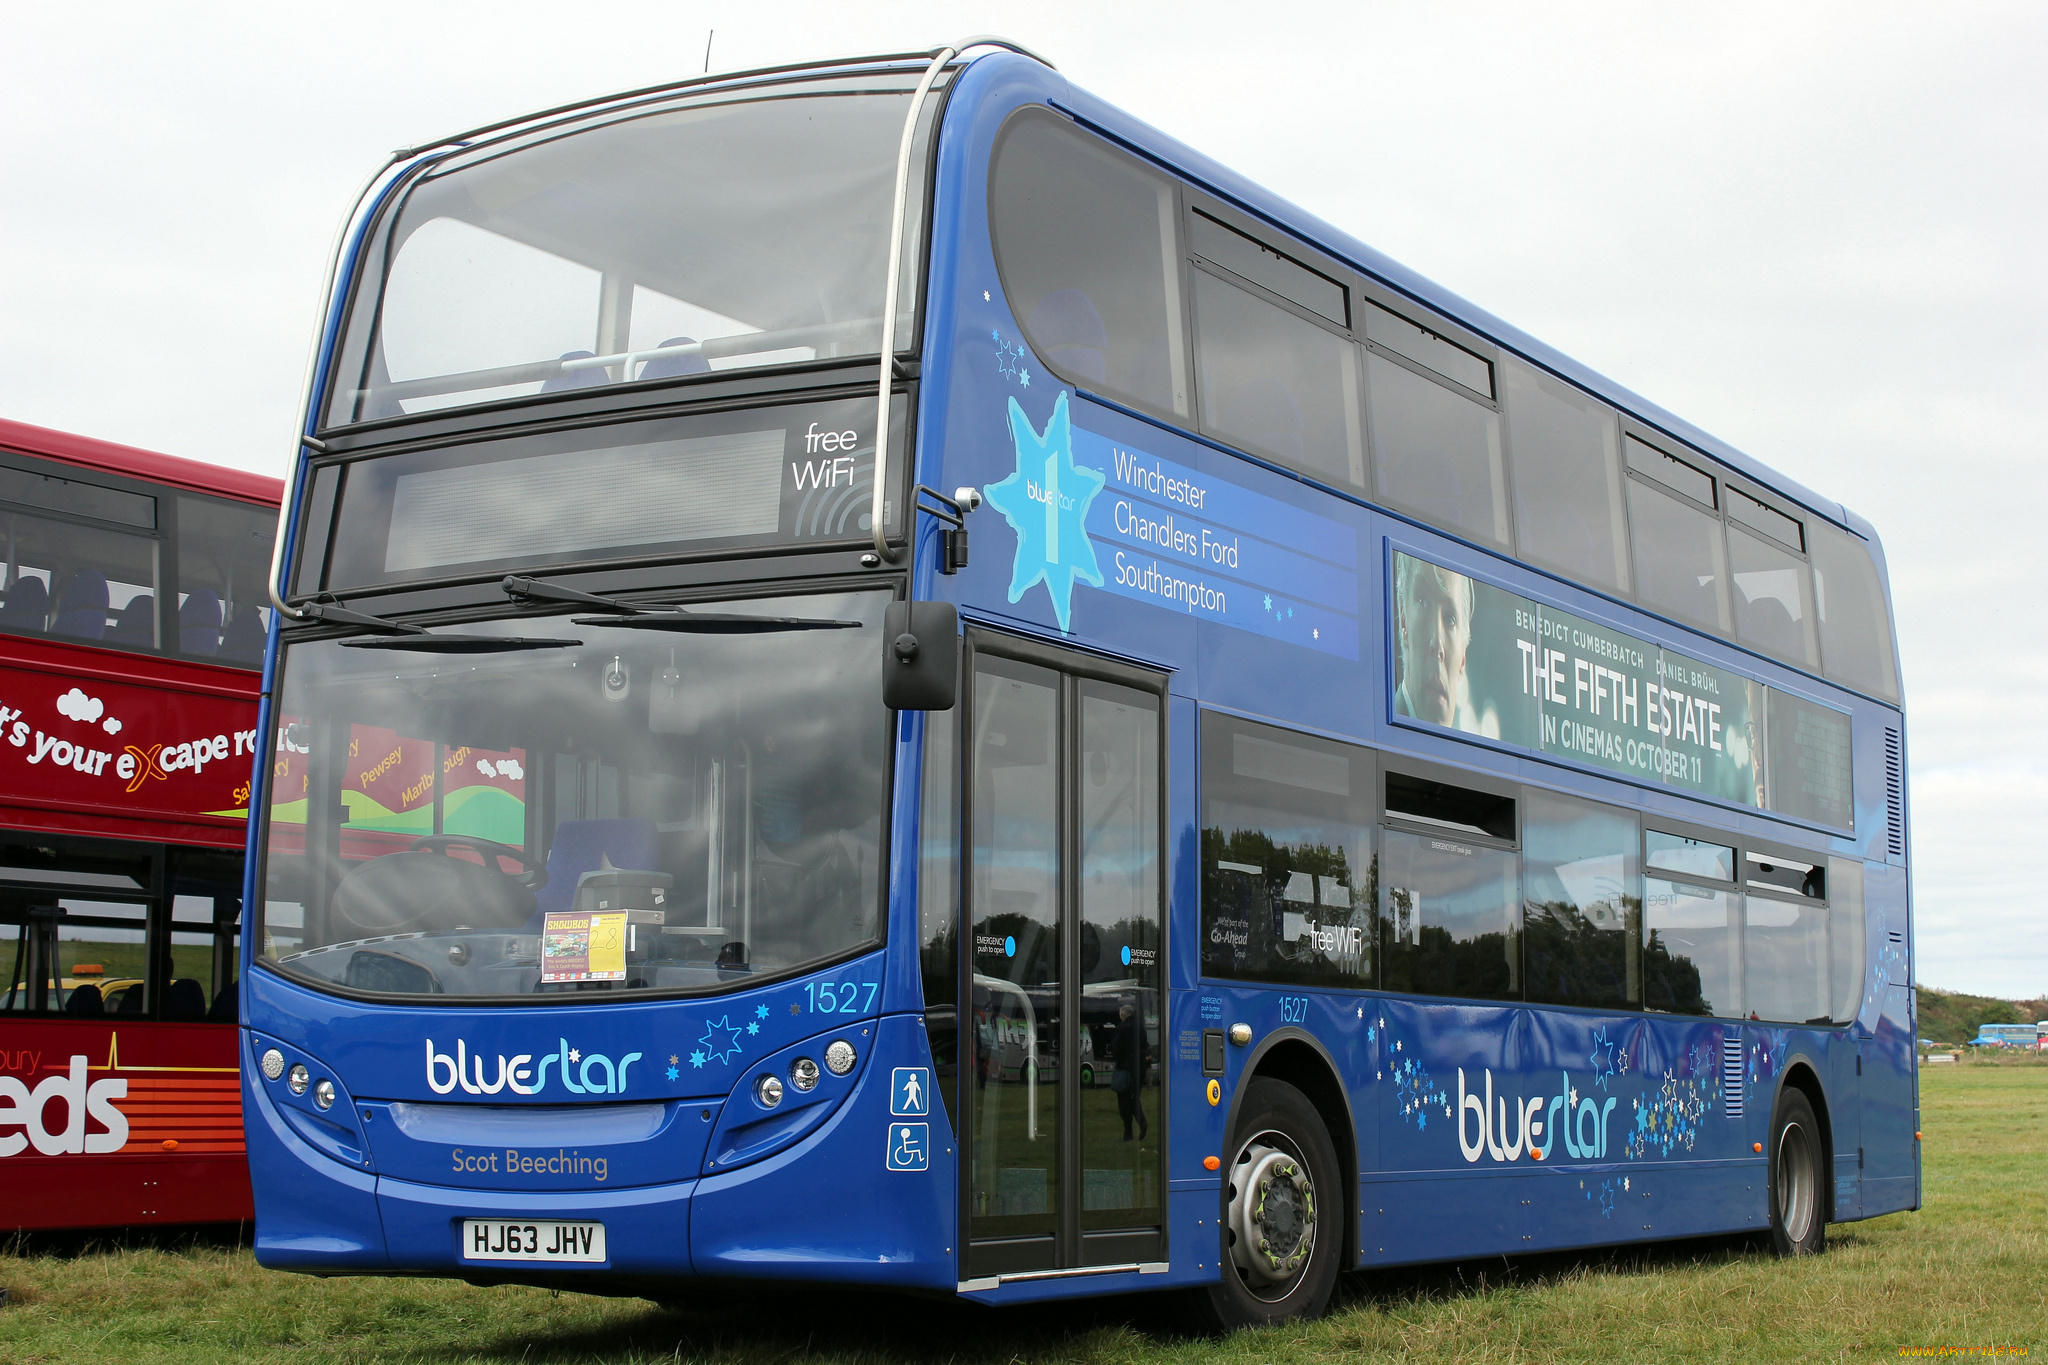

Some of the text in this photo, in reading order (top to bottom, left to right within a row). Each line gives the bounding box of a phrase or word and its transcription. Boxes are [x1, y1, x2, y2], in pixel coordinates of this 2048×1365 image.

[804, 422, 858, 453] free
[792, 457, 855, 491] WiFi
[1113, 448, 1206, 509] Winchester
[1114, 501, 1239, 569] Chandlers Ford
[1115, 551, 1227, 613] Southampton
[1515, 609, 1569, 642] BENEDICT
[1573, 629, 1644, 669] CUMBERBATCH
[1656, 659, 1688, 685] DANIEL
[1517, 638, 1722, 751] THE FIFTH ESTATE
[26, 730, 113, 776] your
[1540, 713, 1701, 783] IN CINEMAS OCTOBER 11
[360, 746, 402, 789] Pewsey
[590, 927, 617, 950] 28
[976, 935, 1005, 946] EMERGENCY
[977, 945, 989, 954] push
[993, 947, 1005, 956] open
[1131, 949, 1157, 958] EMERGENCY
[1211, 928, 1248, 946] Go-Ahead
[1310, 919, 1362, 955] free WiFi
[1130, 956, 1140, 965] push
[1145, 959, 1155, 967] open
[803, 982, 878, 1014] 1527
[1278, 996, 1308, 1023] 1527
[426, 1037, 642, 1095] bluestar
[1458, 1066, 1617, 1163] bluestar
[452, 1149, 609, 1181] Scot Beeching
[474, 1224, 594, 1255] HJ63 JHV
